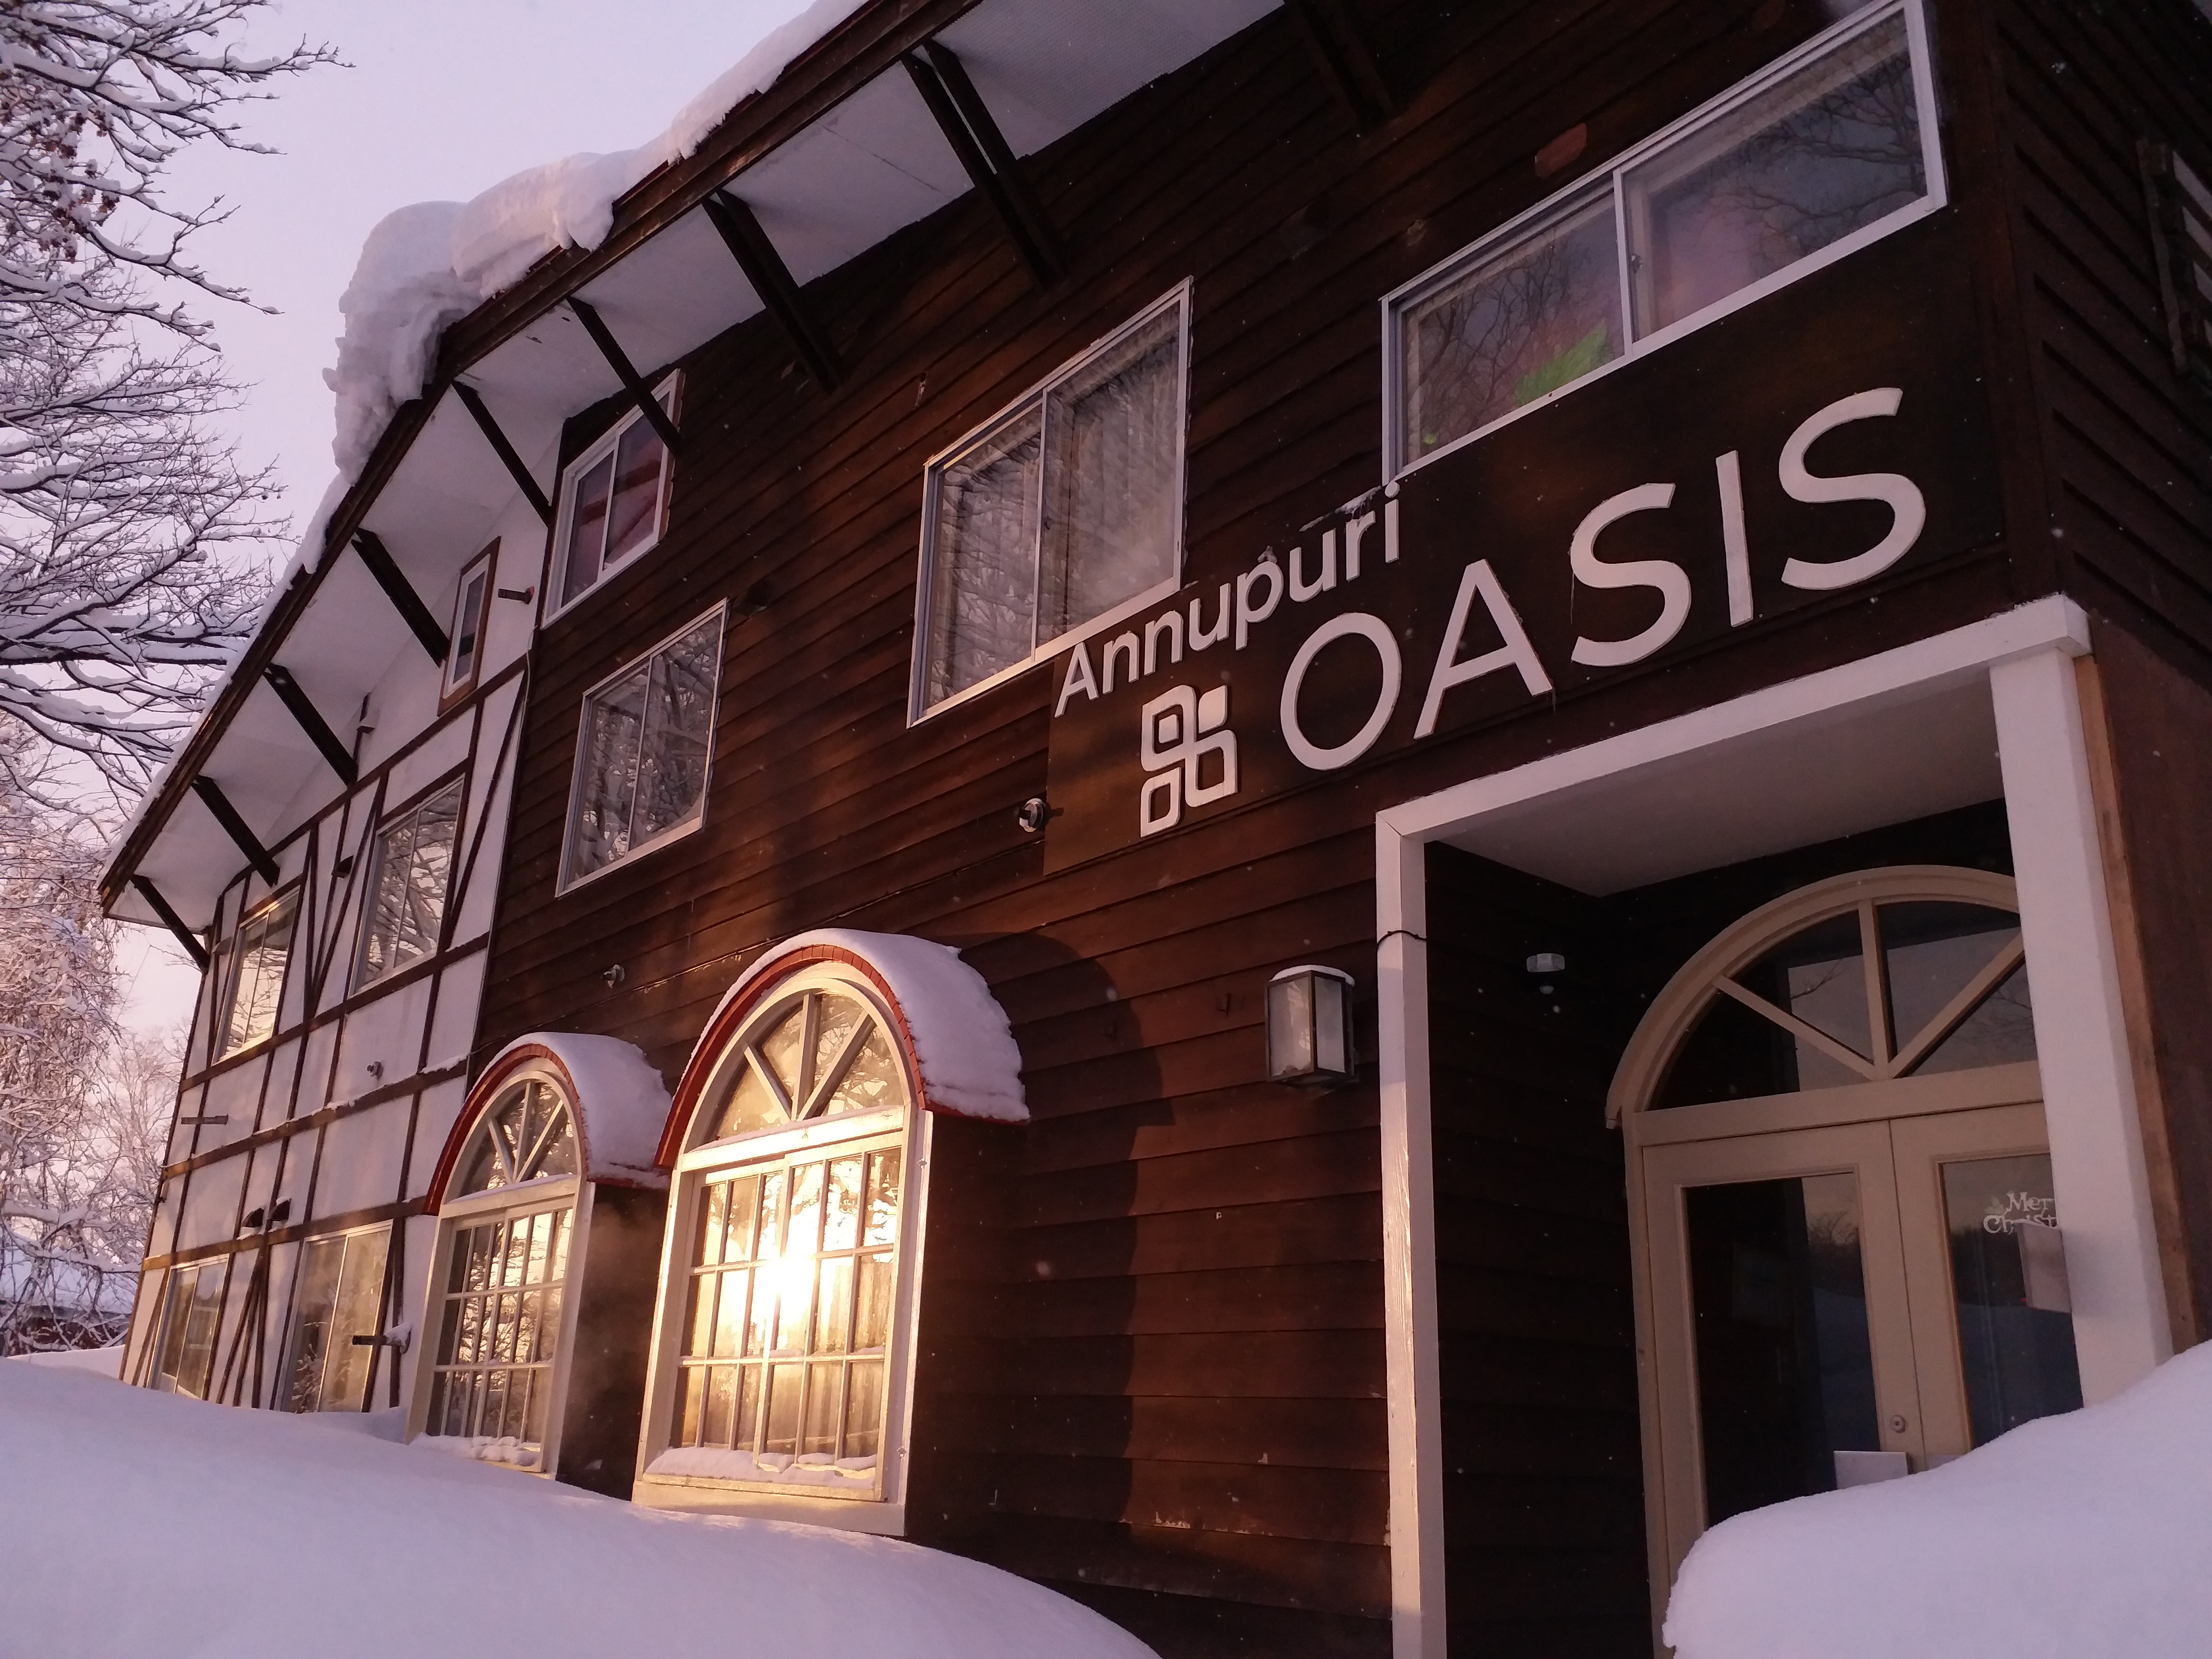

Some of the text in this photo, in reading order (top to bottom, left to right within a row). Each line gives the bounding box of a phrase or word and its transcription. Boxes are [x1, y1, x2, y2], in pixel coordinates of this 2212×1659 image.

[1054, 481, 1401, 718] Annupuri
[1280, 387, 1925, 770] OASIS
[2006, 1190, 2055, 1211] Mer
